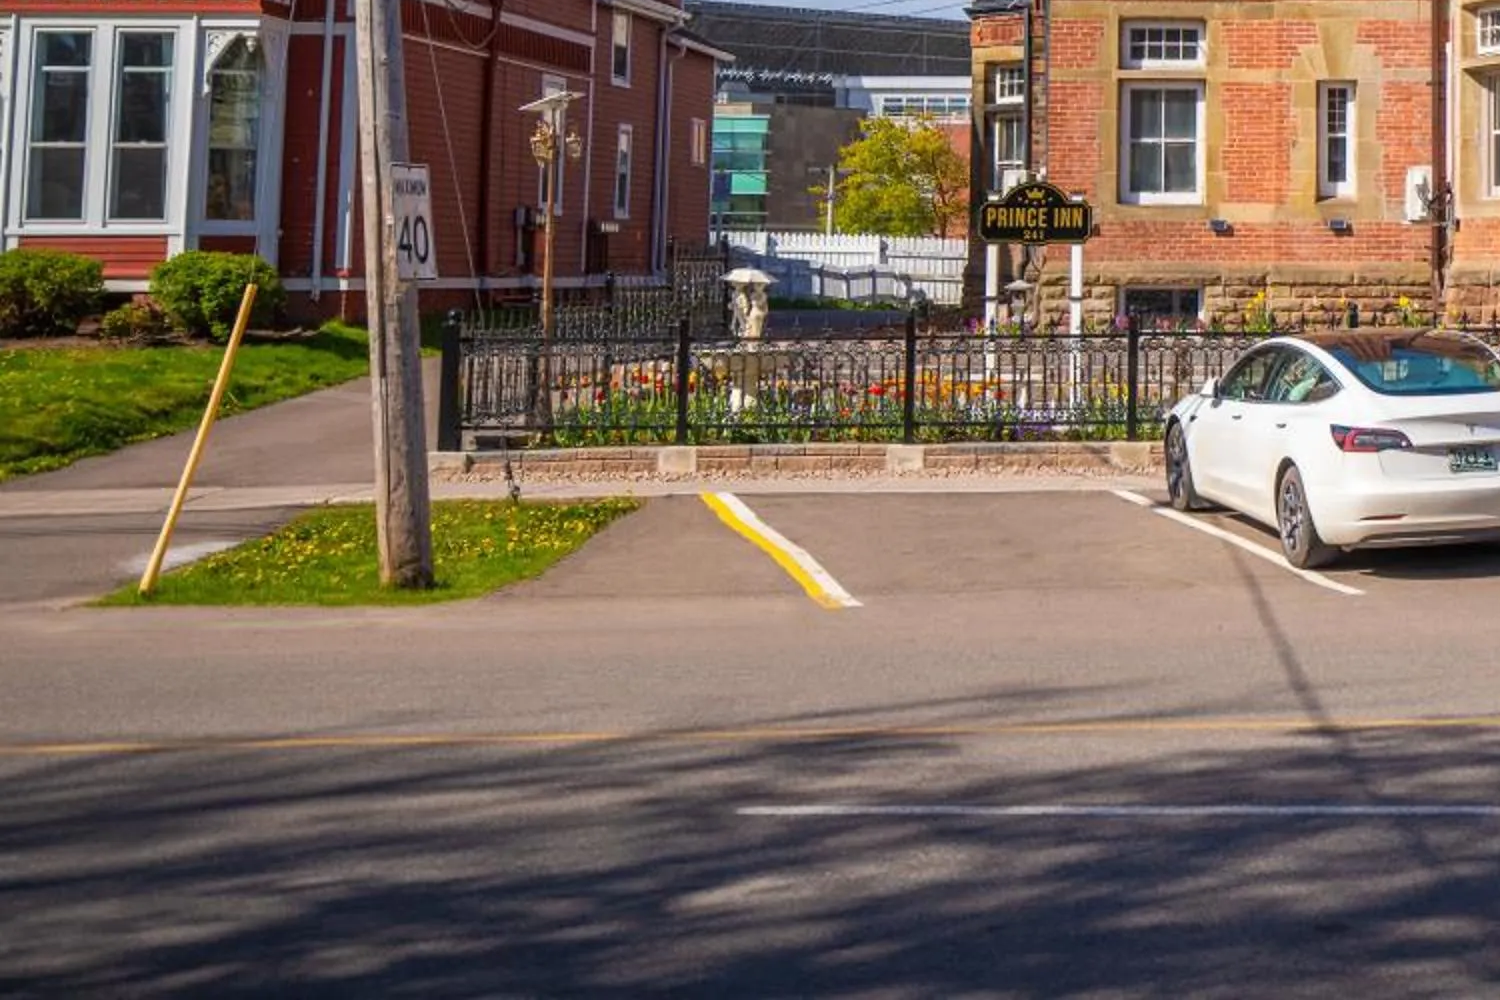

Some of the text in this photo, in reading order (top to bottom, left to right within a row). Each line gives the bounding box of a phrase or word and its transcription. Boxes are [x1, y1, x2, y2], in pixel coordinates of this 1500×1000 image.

[986, 207, 1084, 229] PRINCE INN
[398, 215, 428, 264] 40
